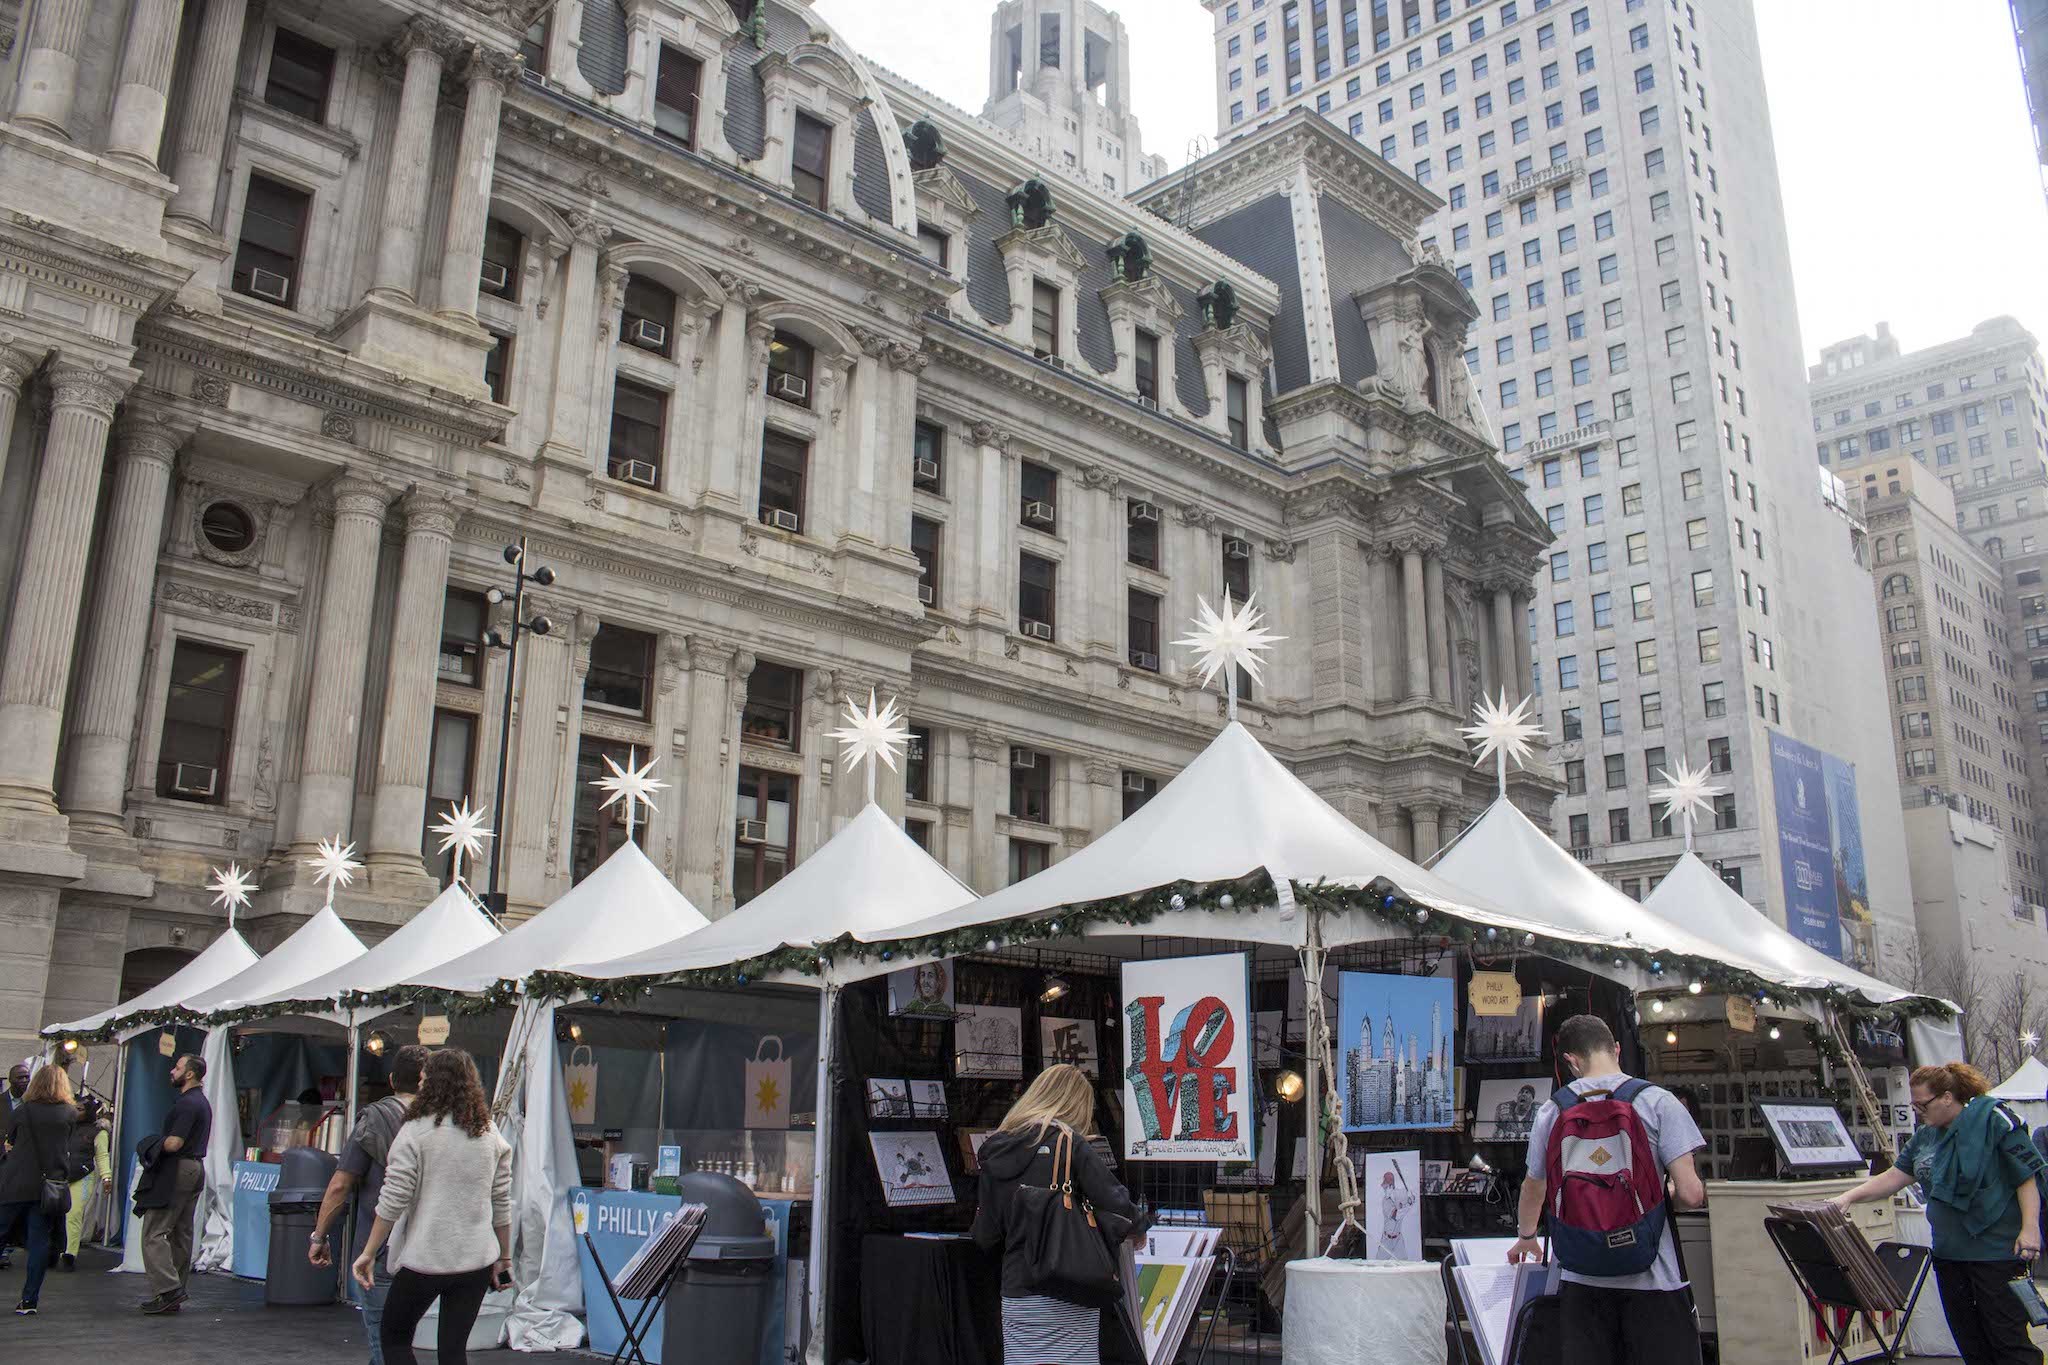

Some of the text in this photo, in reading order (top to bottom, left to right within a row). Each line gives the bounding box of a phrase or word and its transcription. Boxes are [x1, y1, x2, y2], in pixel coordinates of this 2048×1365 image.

[1486, 981, 1504, 992] PHILLY
[1482, 995, 1509, 1006] WORD ART
[240, 1171, 276, 1192] PHILLY
[597, 1205, 657, 1236] PHILLY
